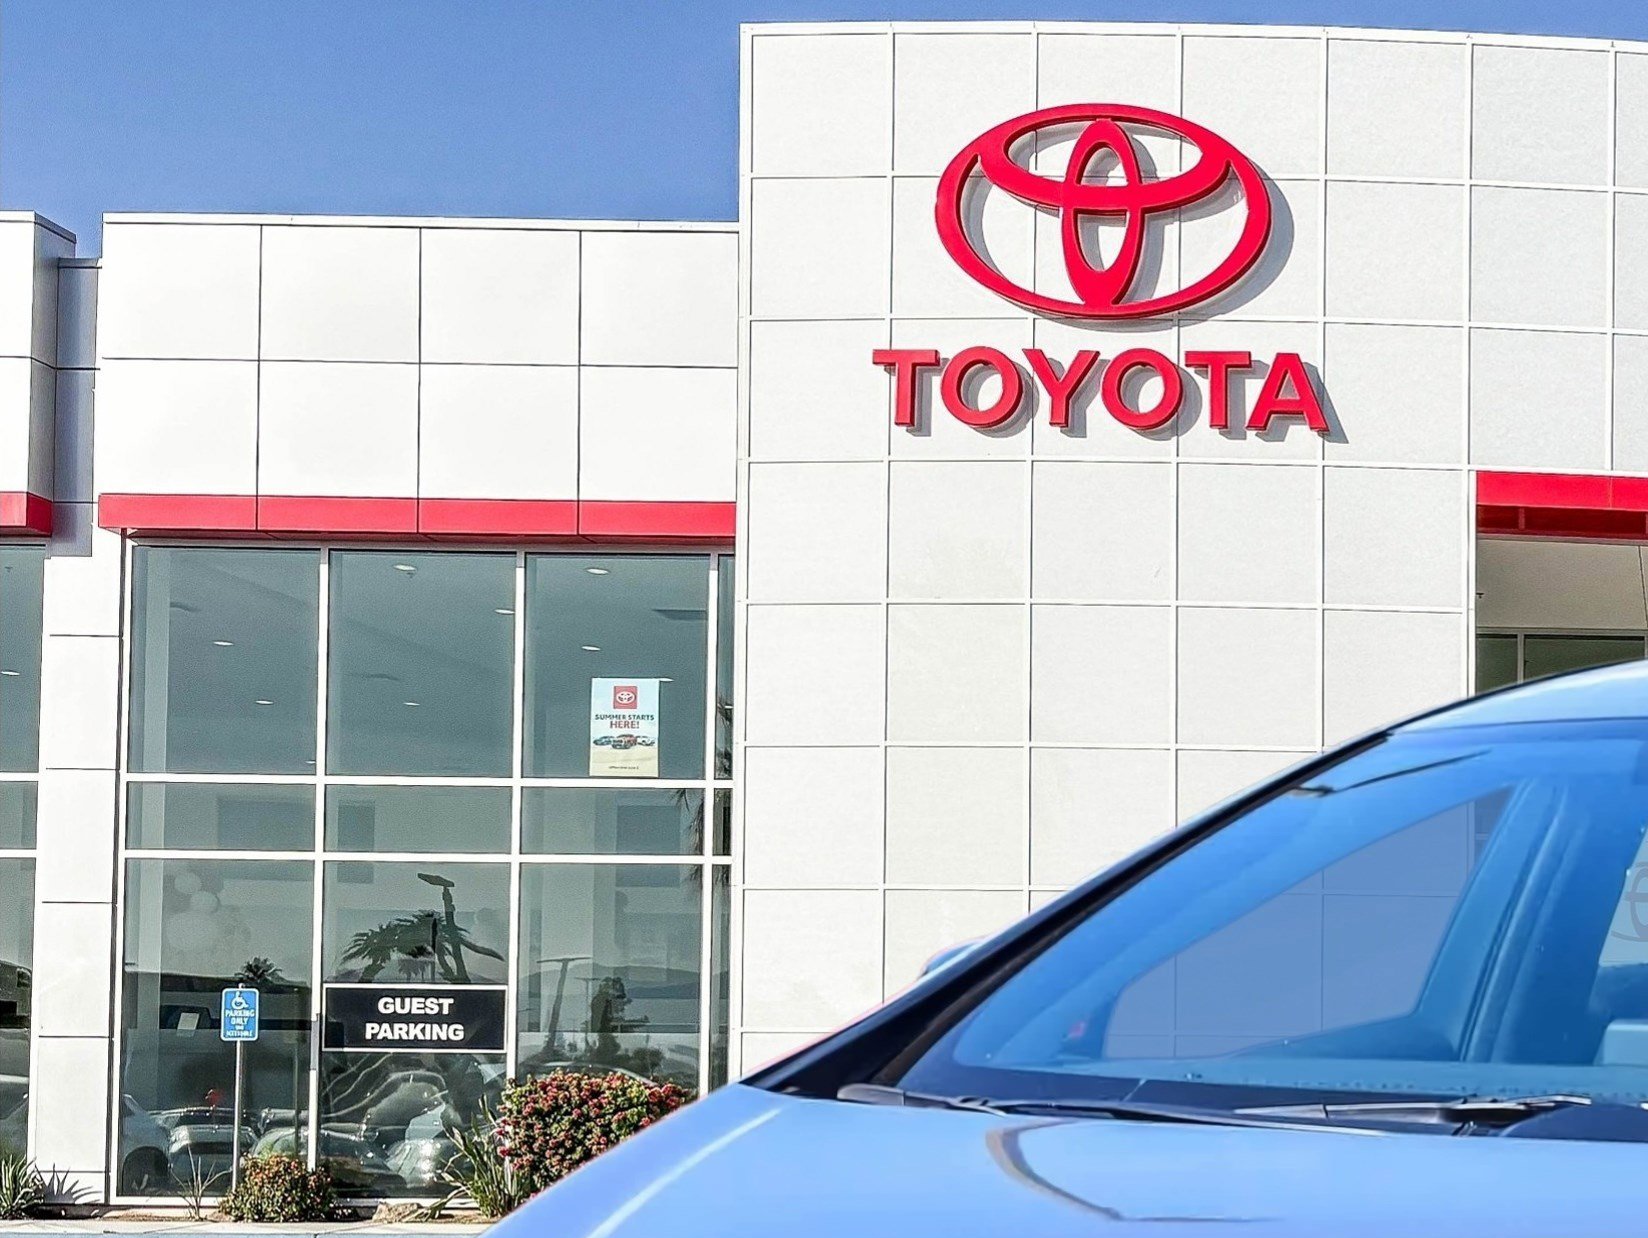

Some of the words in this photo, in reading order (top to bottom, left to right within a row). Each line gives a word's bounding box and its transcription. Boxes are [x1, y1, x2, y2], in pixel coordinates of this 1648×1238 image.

[873, 346, 1329, 433] TOYOTA
[610, 721, 640, 729] HERE!
[378, 997, 454, 1015] GUEST
[365, 1023, 464, 1041] PARKING
